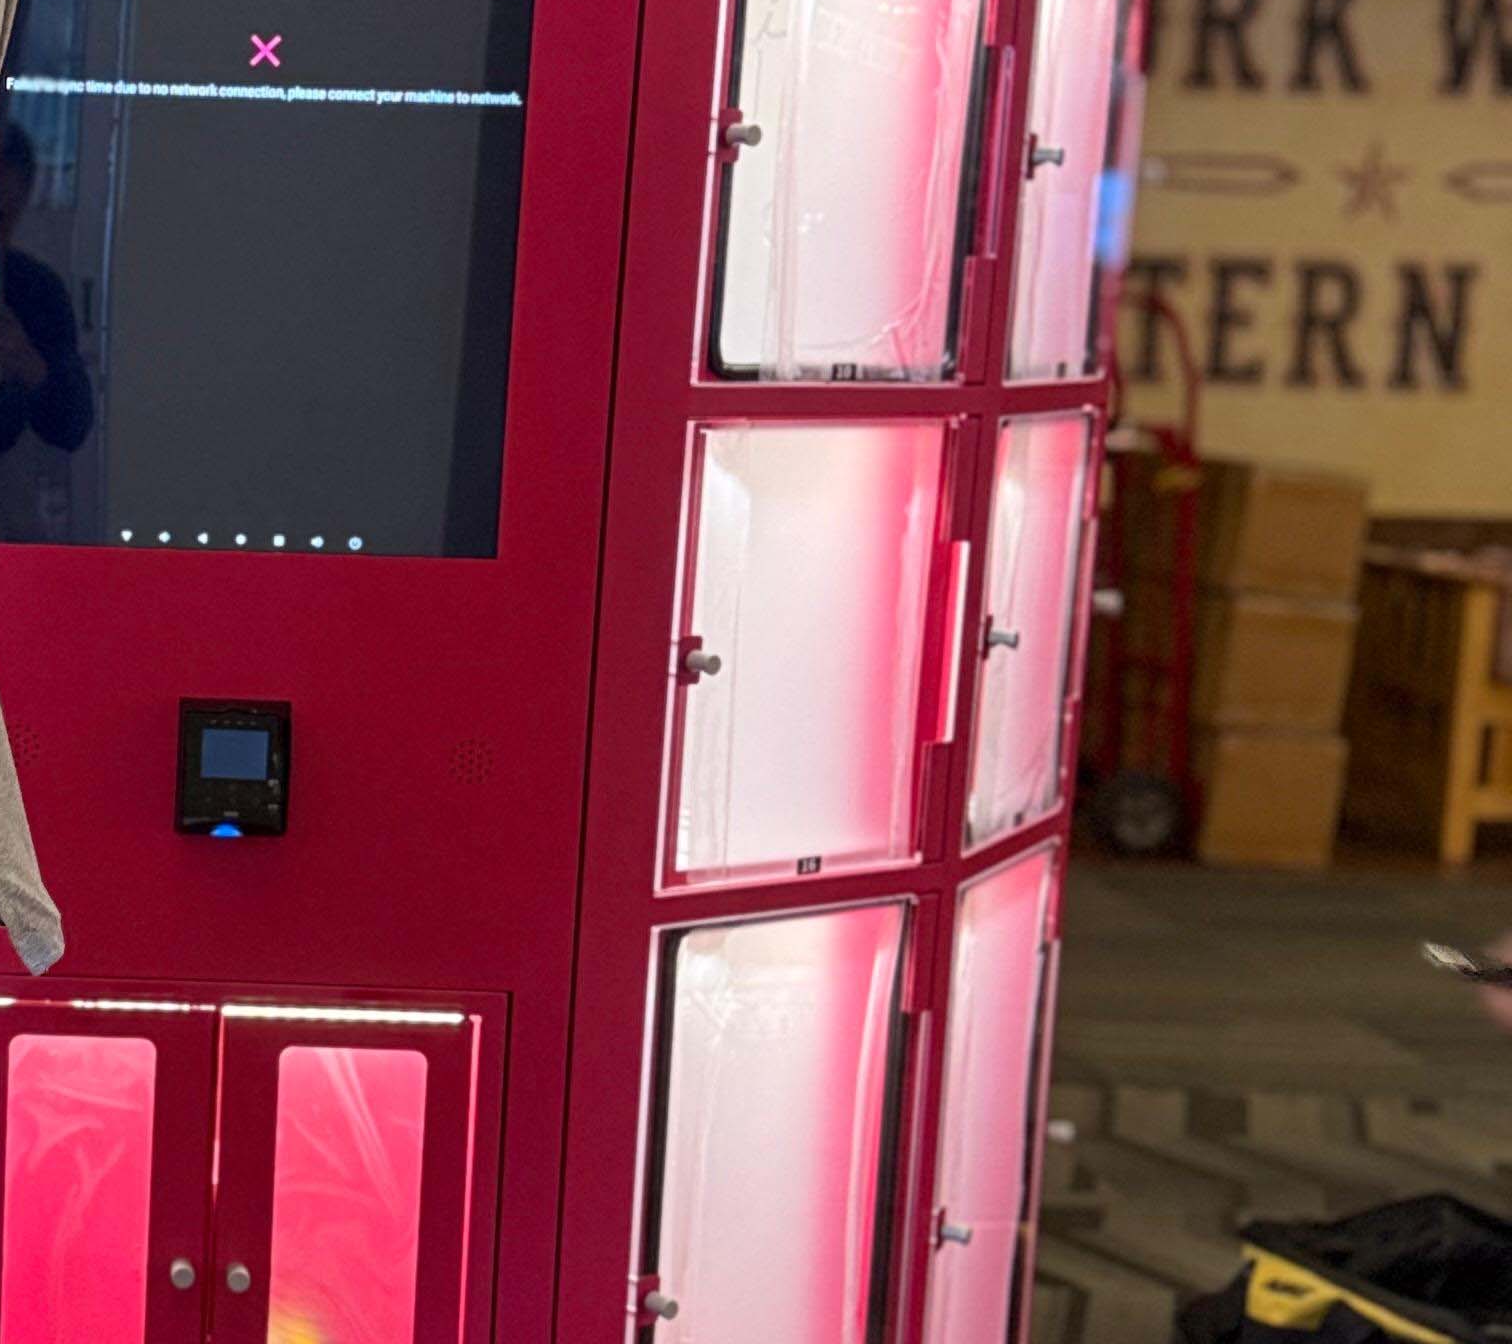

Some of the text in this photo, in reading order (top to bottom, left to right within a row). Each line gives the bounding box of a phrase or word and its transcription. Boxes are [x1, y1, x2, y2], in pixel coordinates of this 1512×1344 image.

[114, 79, 137, 95] due
[138, 81, 151, 96] to
[152, 84, 168, 96] no
[169, 83, 219, 98] network
[287, 85, 327, 103] please
[327, 88, 376, 102] connect
[376, 91, 404, 105] your
[404, 89, 454, 104] machine
[456, 91, 470, 105] to
